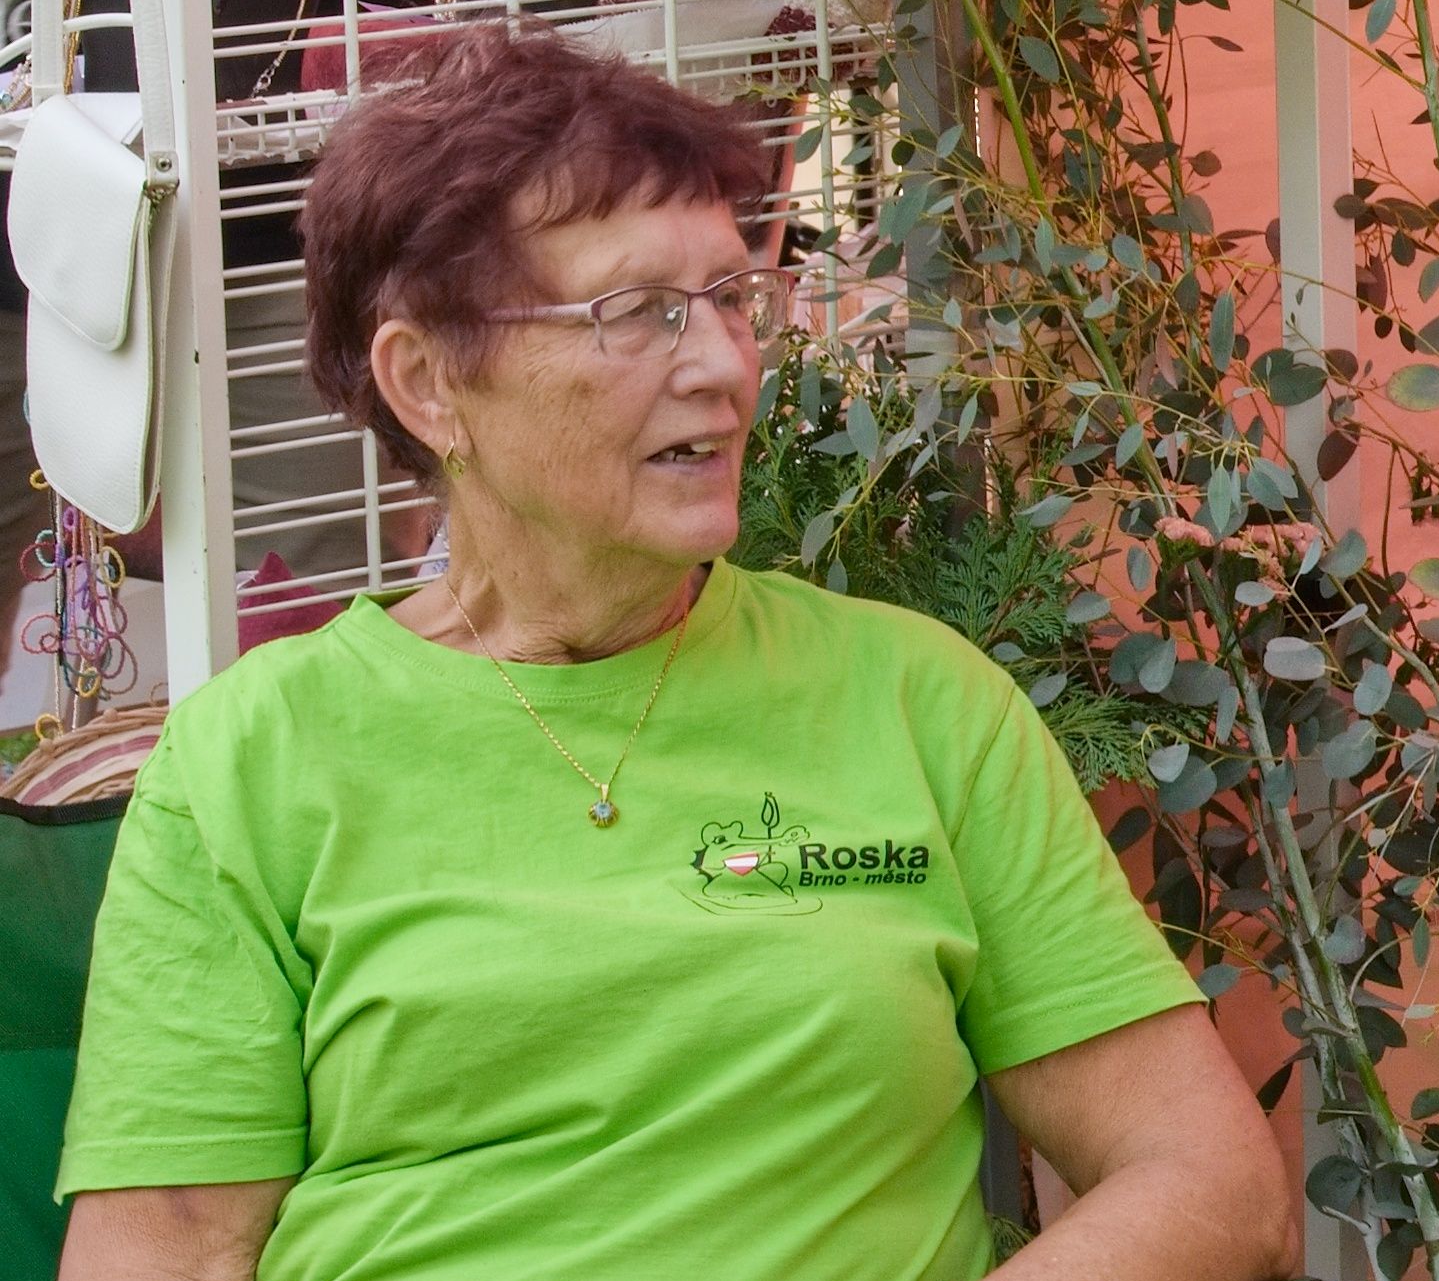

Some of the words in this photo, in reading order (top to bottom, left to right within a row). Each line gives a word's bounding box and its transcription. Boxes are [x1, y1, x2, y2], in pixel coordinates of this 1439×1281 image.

[799, 839, 930, 870] Roska
[799, 871, 847, 887] Brno
[865, 869, 926, 885] město
